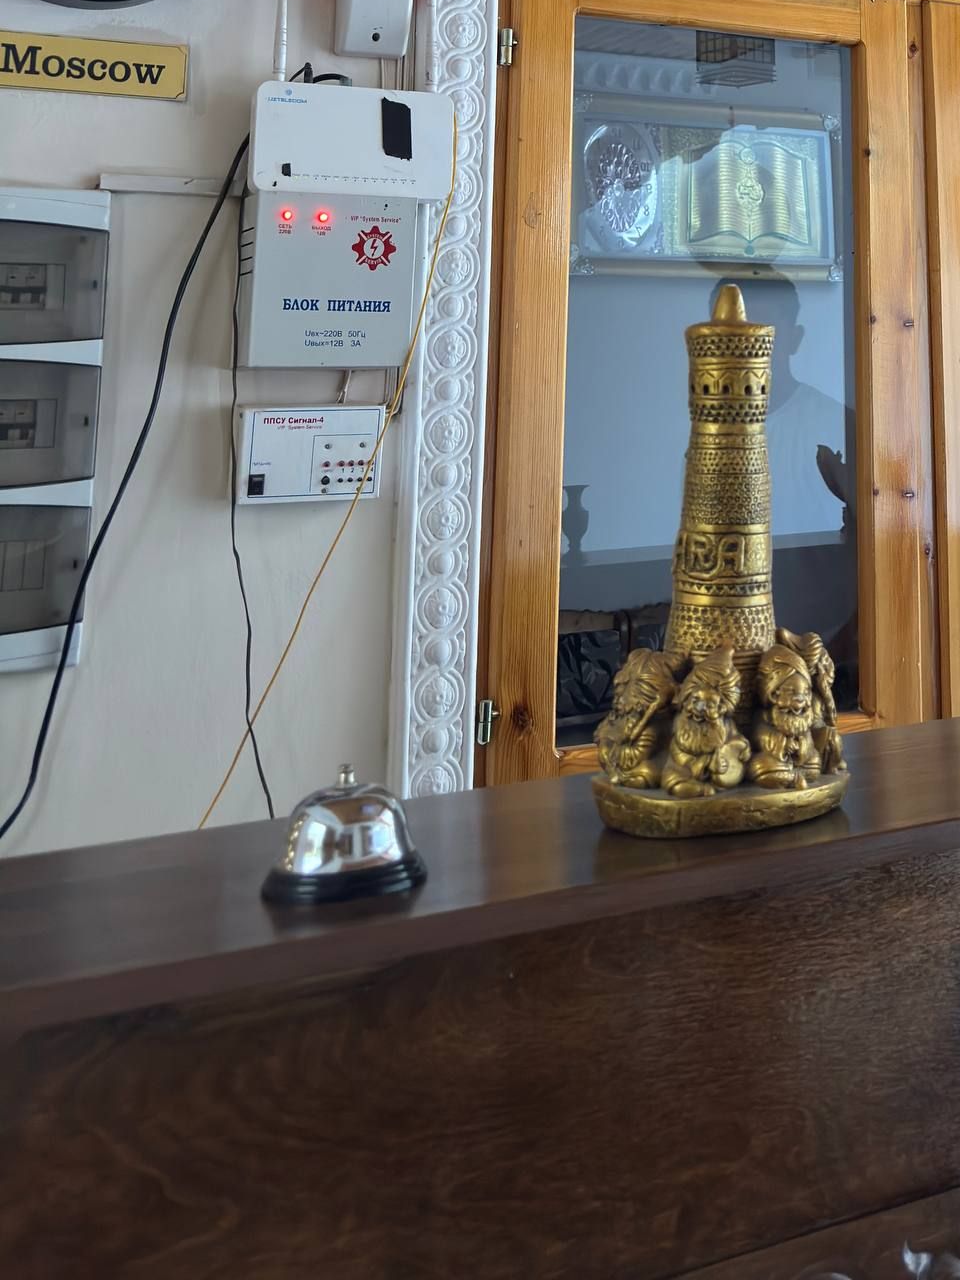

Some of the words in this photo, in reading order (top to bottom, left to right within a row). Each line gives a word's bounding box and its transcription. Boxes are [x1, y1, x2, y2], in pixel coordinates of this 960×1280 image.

[0, 43, 166, 85] Moscow
[282, 298, 320, 311] БЛОК
[327, 299, 391, 312] ПИТАНИЯ
[348, 330, 366, 338] 50Гц
[288, 416, 324, 424] Сигнал-4
